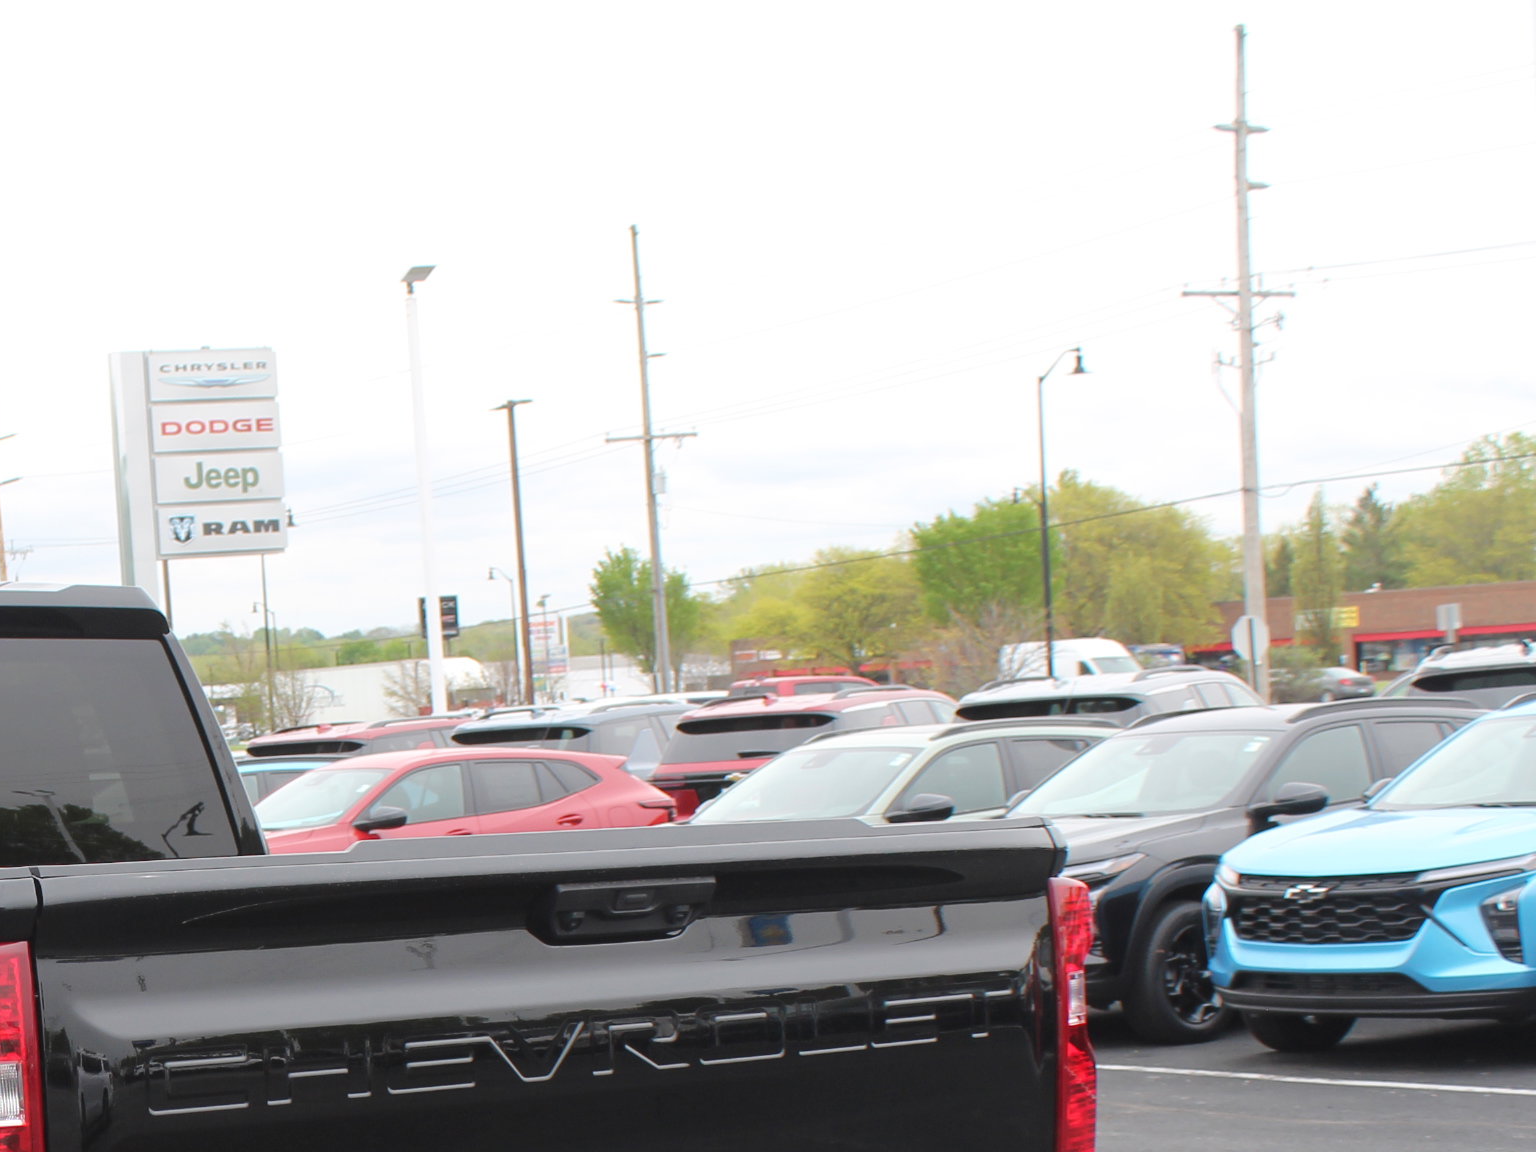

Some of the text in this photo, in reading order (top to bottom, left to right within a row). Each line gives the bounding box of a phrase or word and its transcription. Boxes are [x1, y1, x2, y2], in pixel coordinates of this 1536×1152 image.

[159, 360, 268, 374] CHRYSLER
[161, 418, 274, 436] DODGE
[183, 461, 259, 493] Jeep
[202, 518, 280, 536] RAM
[148, 986, 1018, 1117] CHEVROLET
